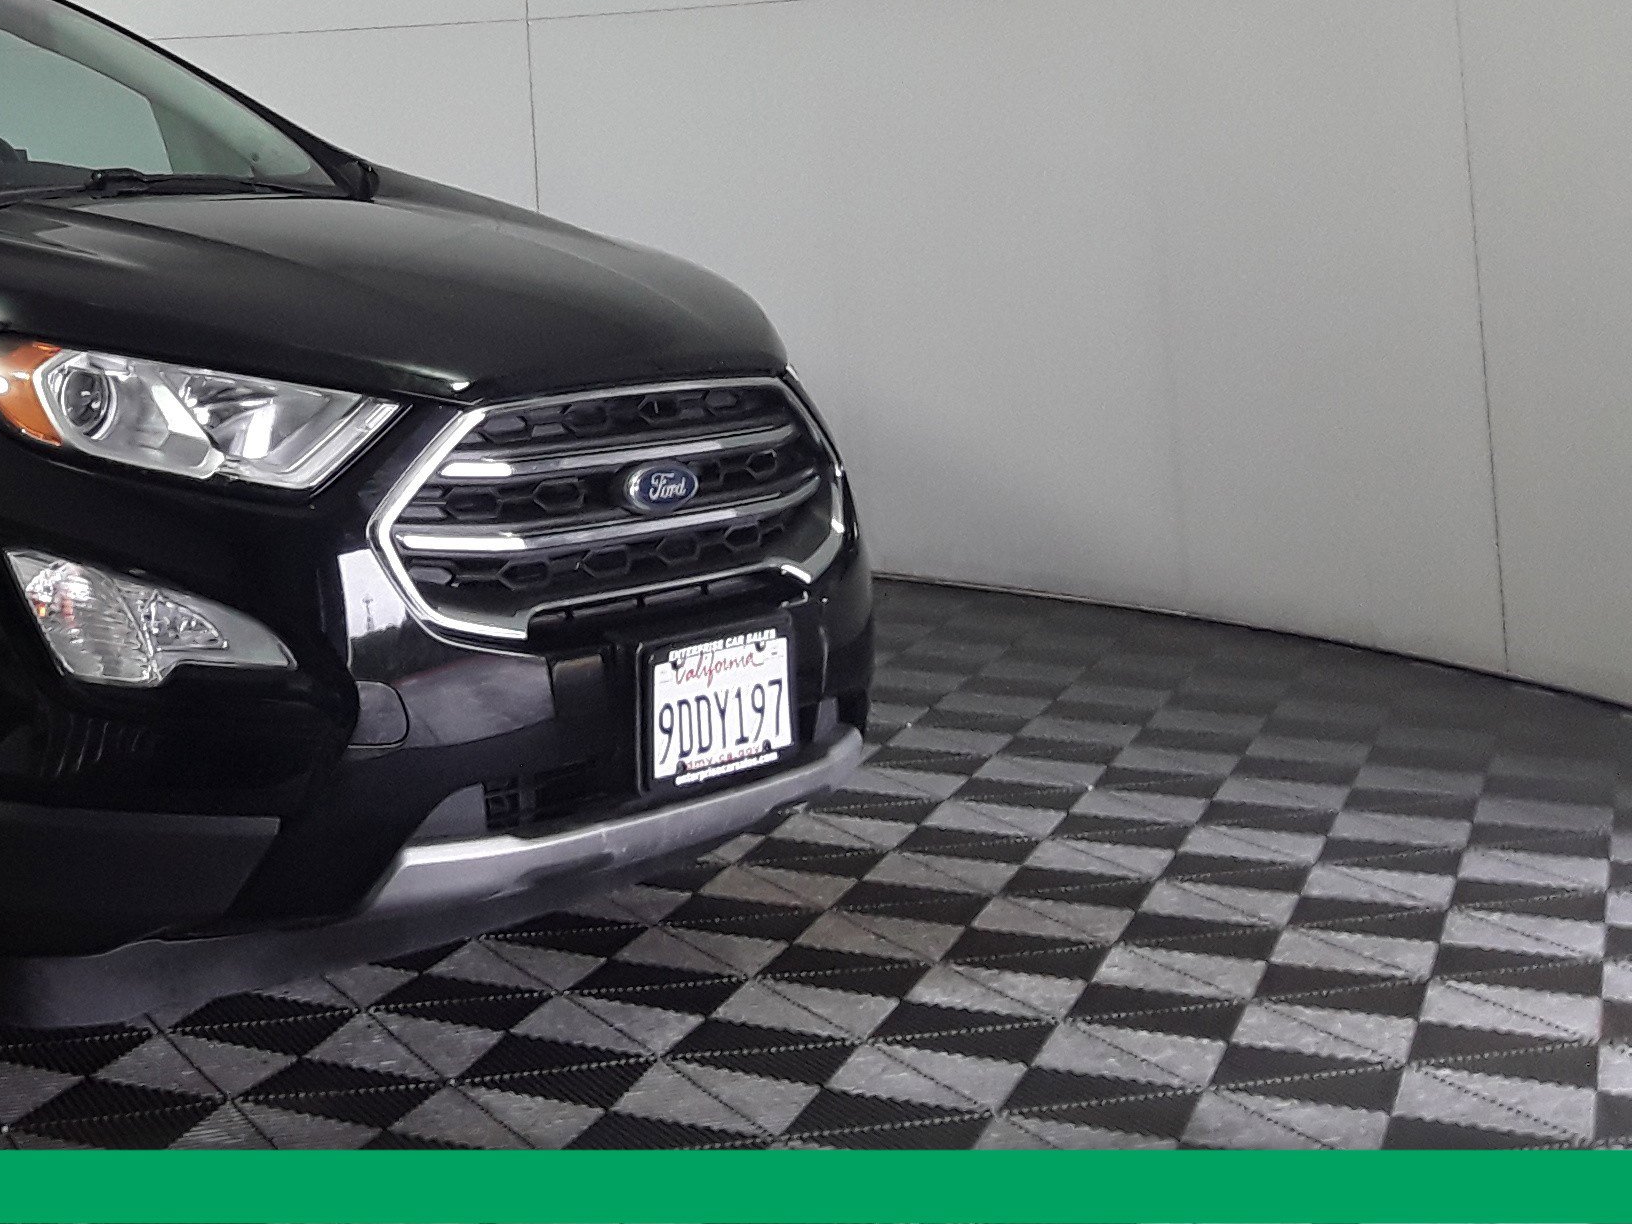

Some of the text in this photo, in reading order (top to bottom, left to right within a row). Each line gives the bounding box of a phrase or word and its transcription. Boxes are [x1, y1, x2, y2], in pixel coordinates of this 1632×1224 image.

[649, 473, 686, 501] Ford
[676, 650, 764, 688] California
[658, 678, 783, 765] 9DDY197
